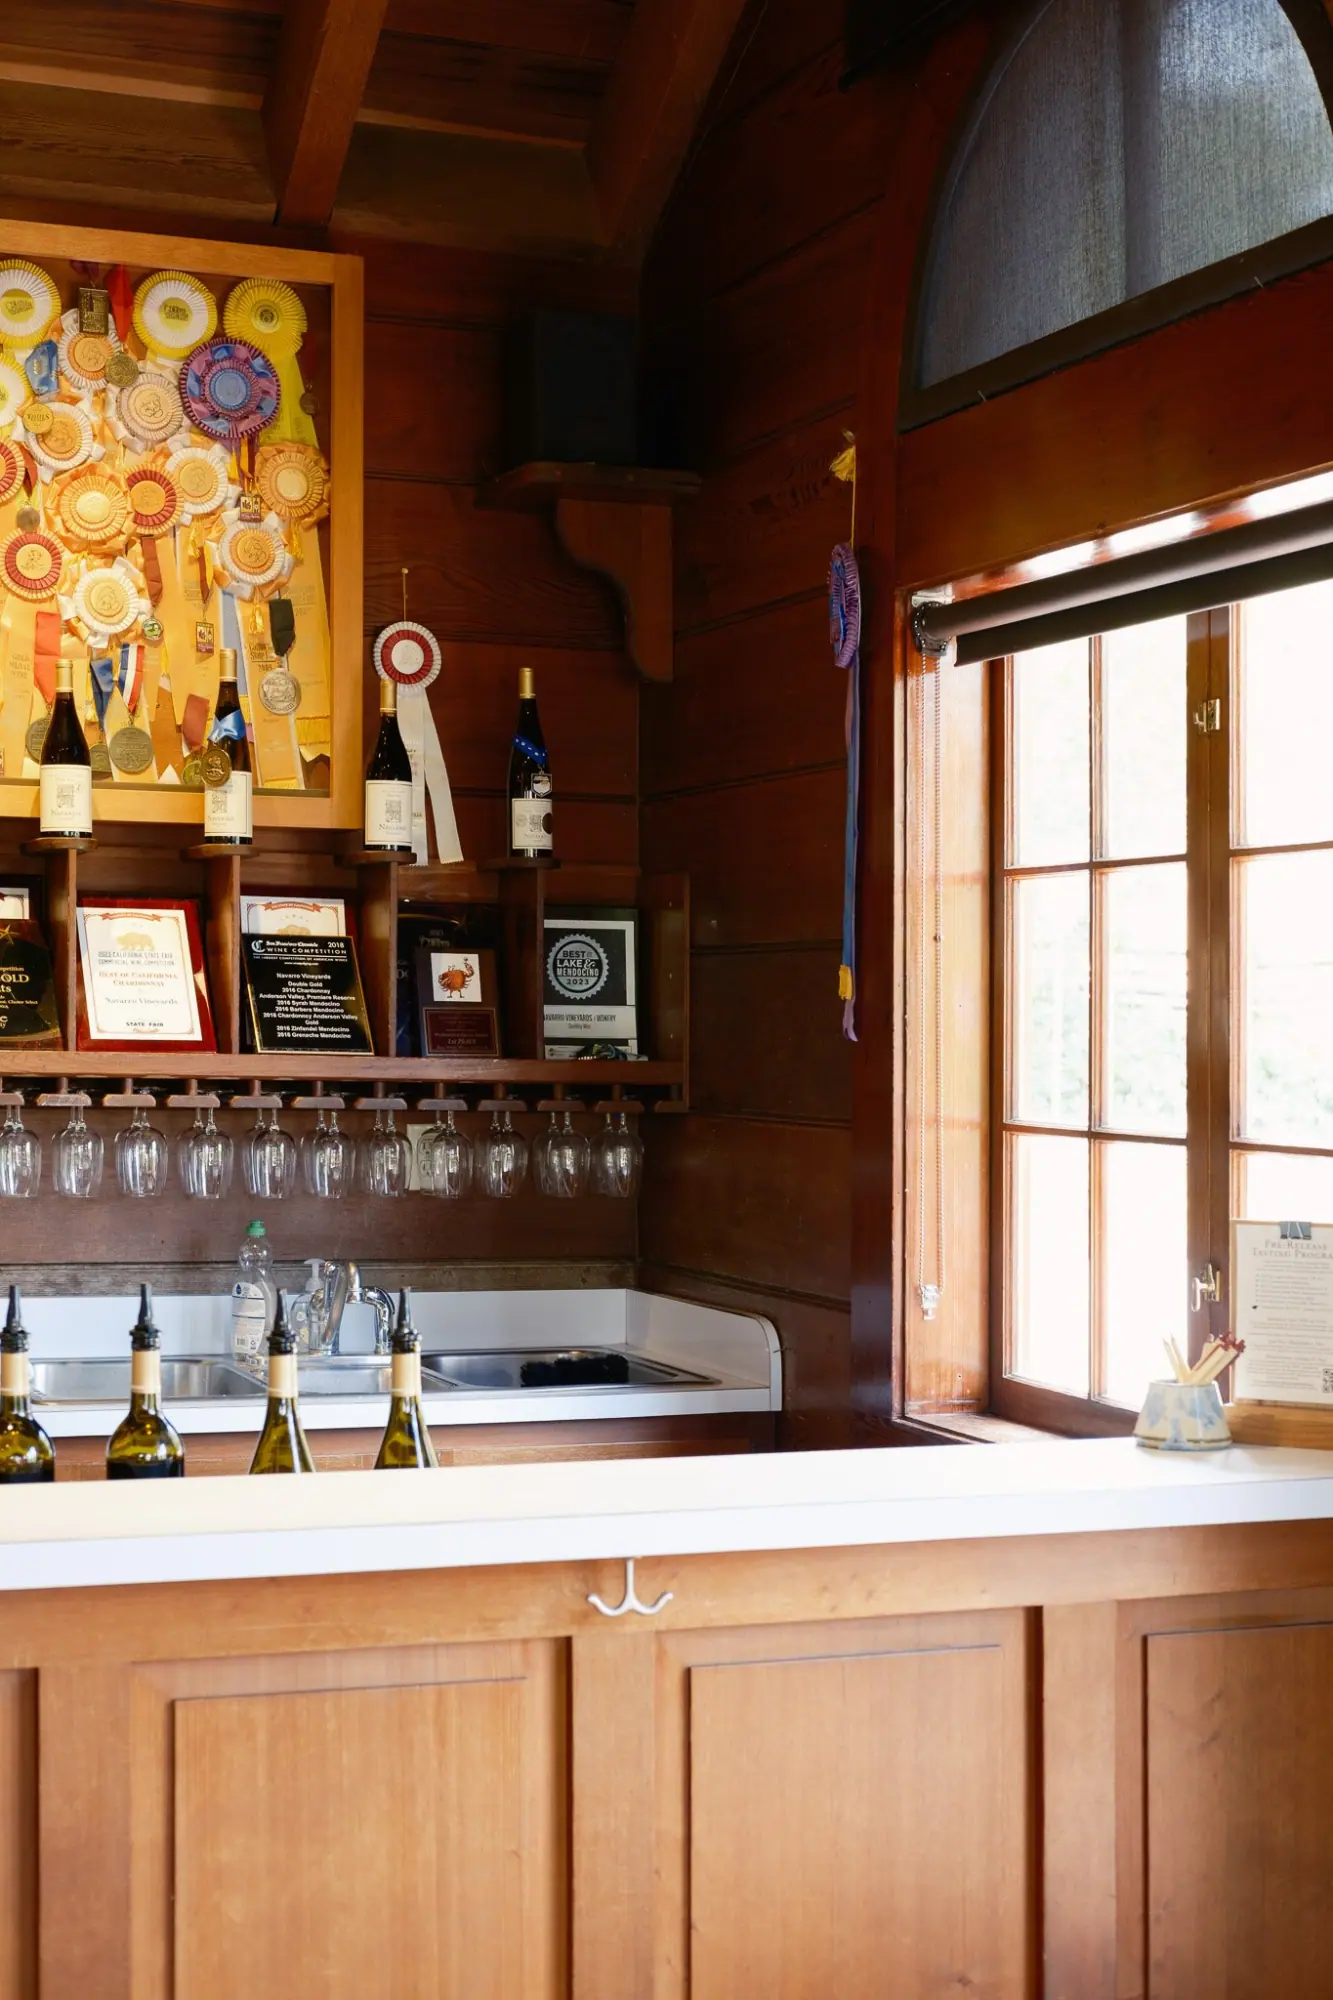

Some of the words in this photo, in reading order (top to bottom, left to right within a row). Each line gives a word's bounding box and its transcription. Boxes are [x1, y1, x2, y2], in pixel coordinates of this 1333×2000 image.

[584, 959, 596, 970] &
[557, 968, 599, 976] MENDOCINO
[1252, 1248, 1292, 1257] TASTING
